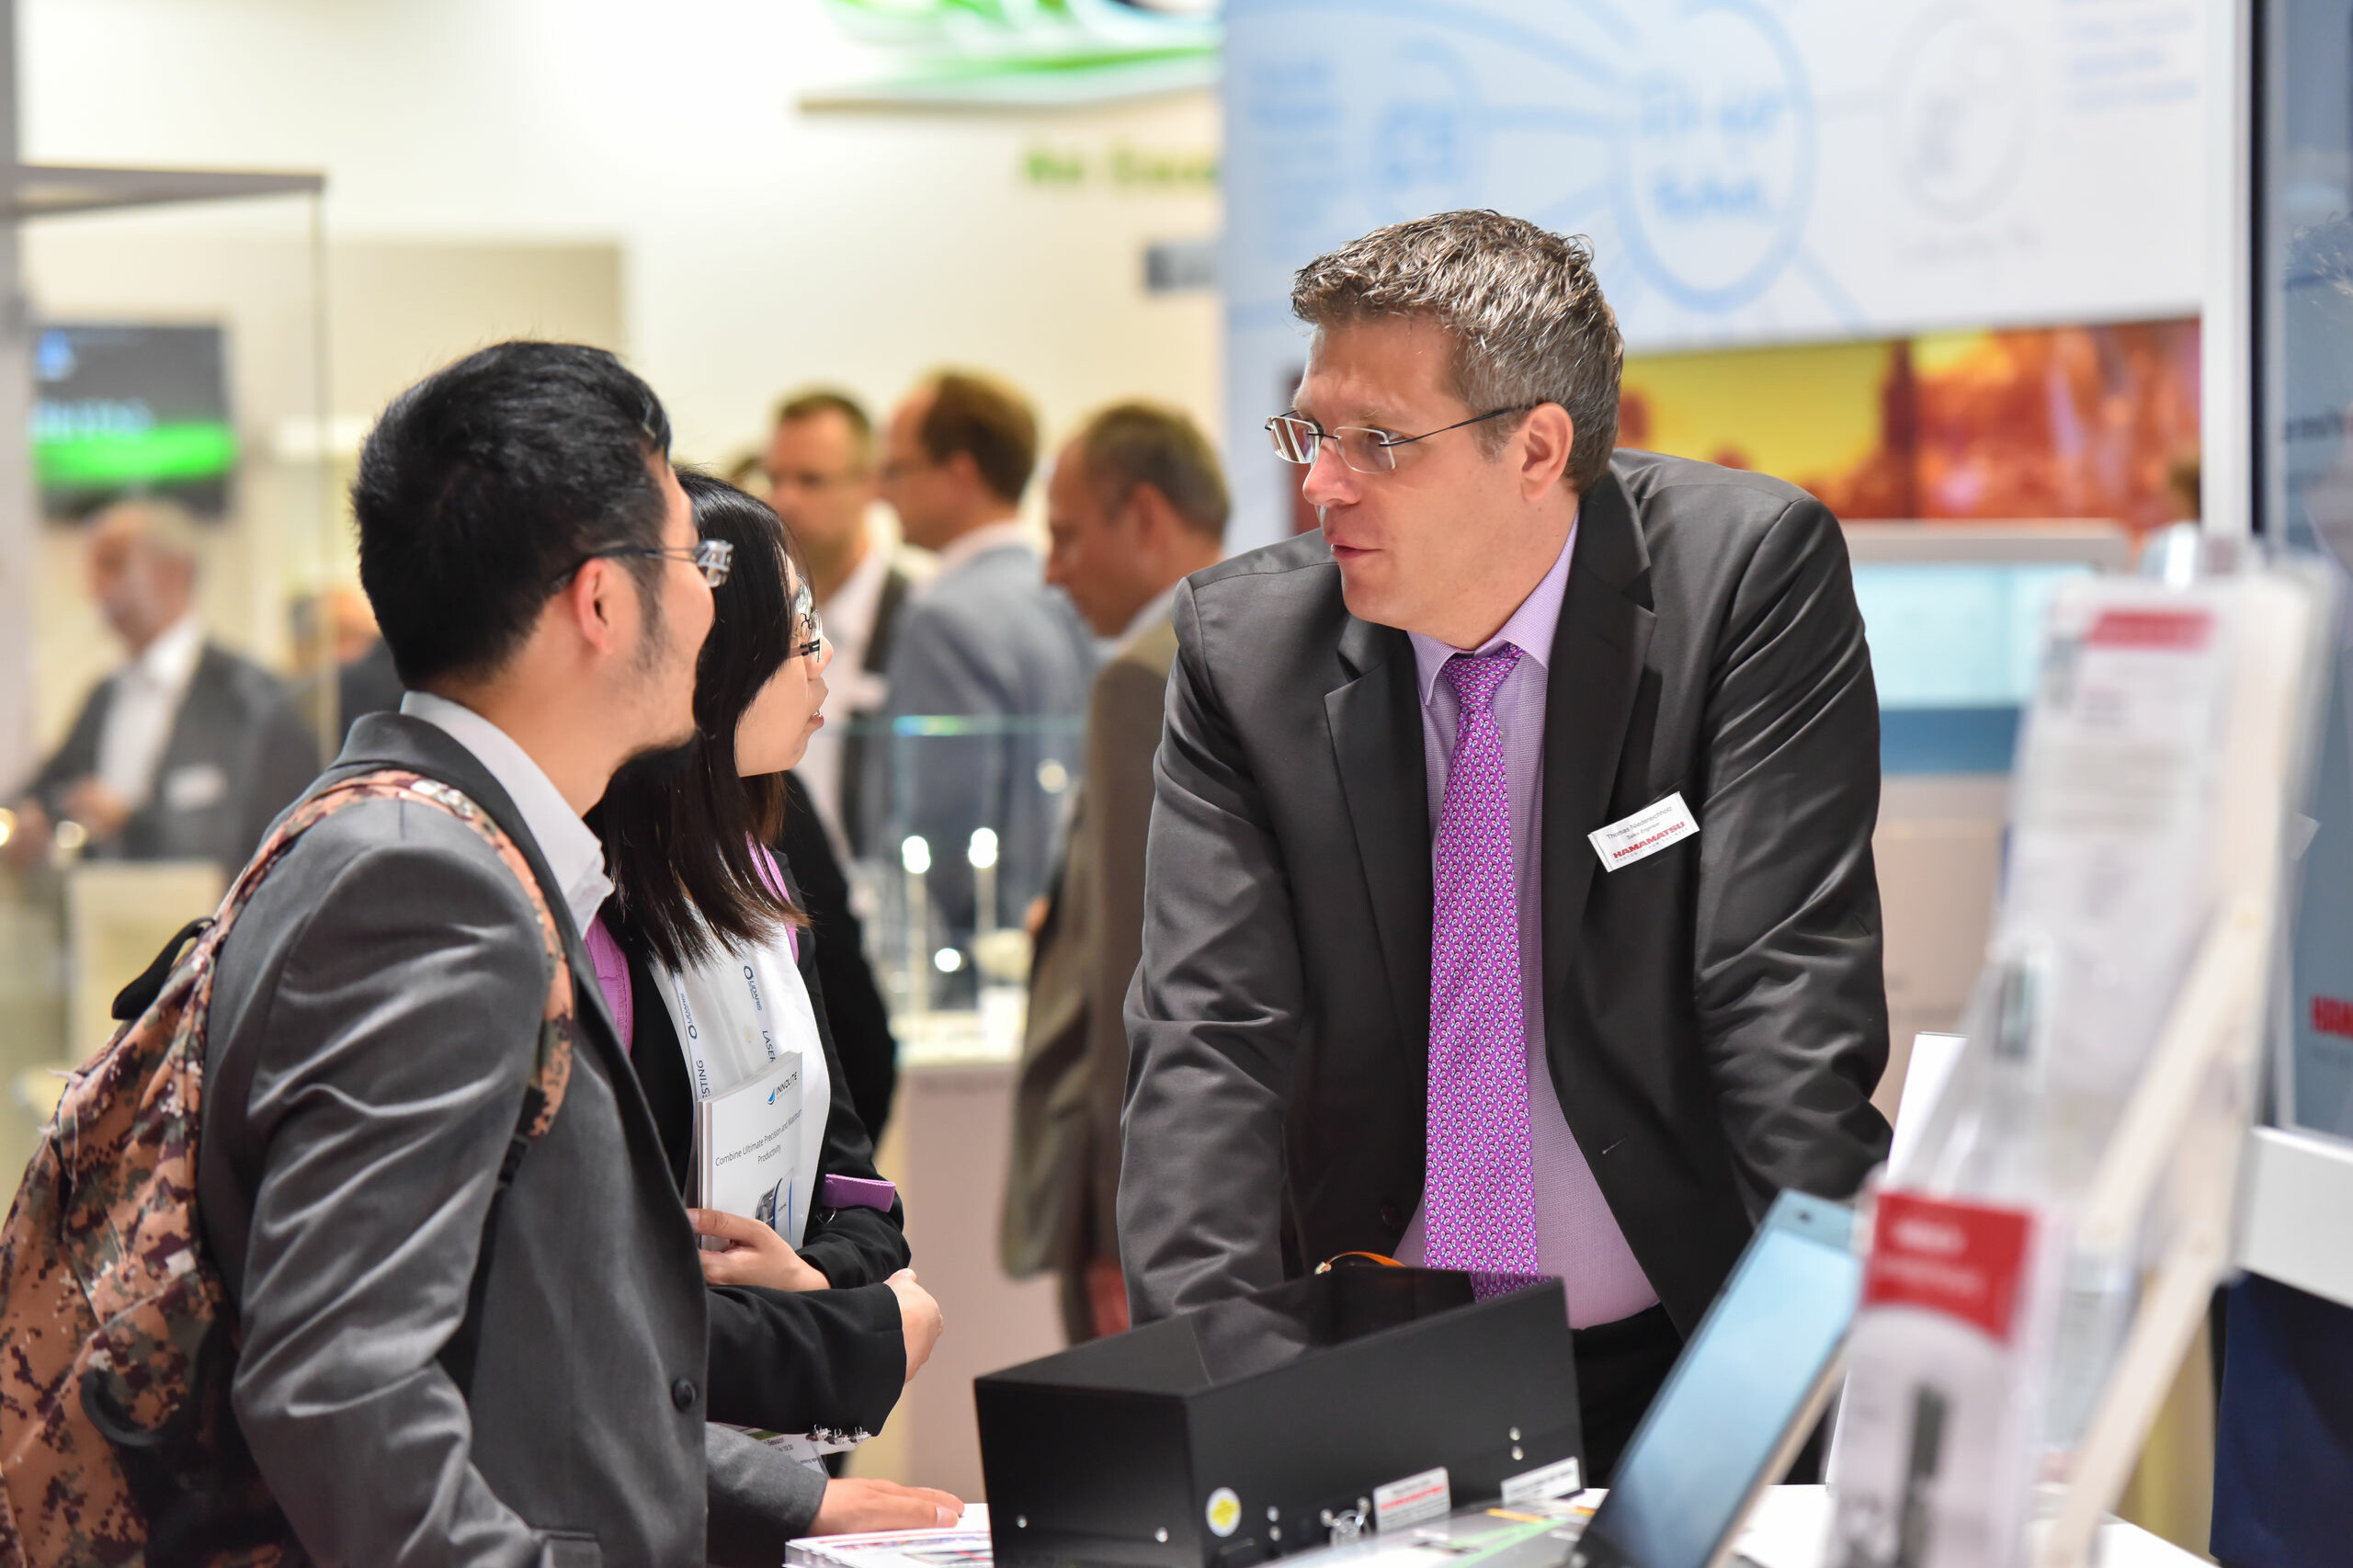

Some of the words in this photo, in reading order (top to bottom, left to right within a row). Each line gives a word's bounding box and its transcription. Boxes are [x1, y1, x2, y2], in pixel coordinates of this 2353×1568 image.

[1613, 821, 1686, 858] HAMAMATSU
[715, 1150, 742, 1166] Combine
[743, 1139, 764, 1155] Ultimate
[764, 1128, 781, 1144] Precision
[757, 1144, 781, 1165] Productivity
